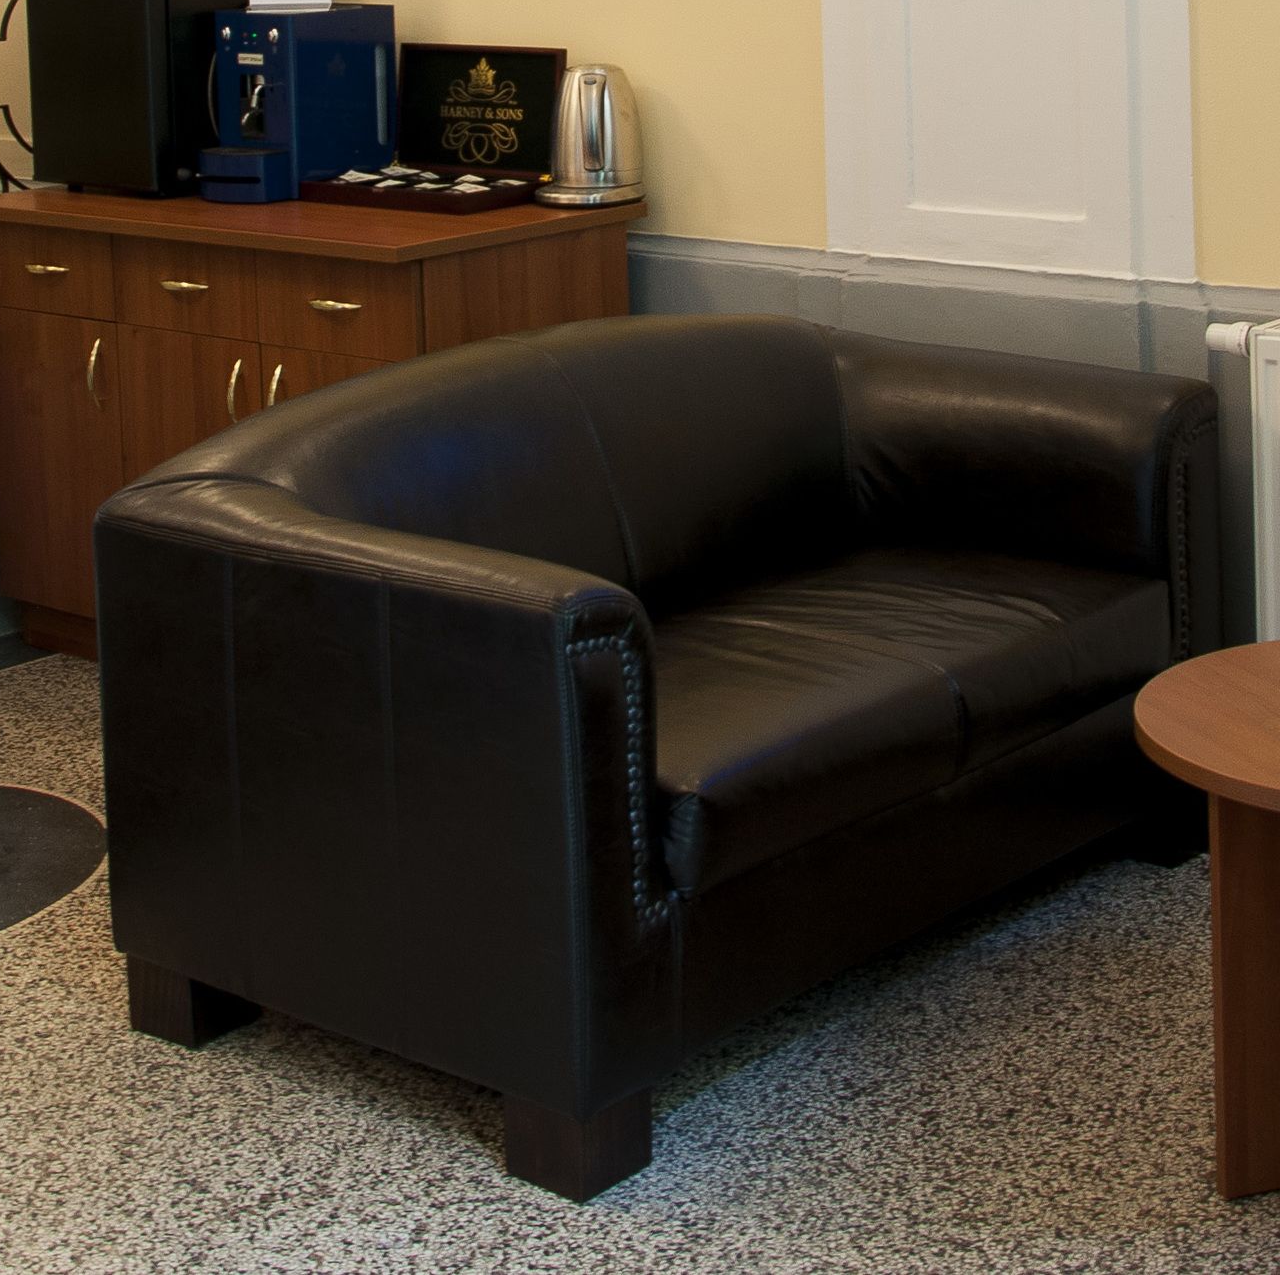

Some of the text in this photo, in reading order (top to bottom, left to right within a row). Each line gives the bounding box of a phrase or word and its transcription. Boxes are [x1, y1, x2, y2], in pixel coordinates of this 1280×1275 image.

[440, 105, 524, 121] HARNEY & SONS
